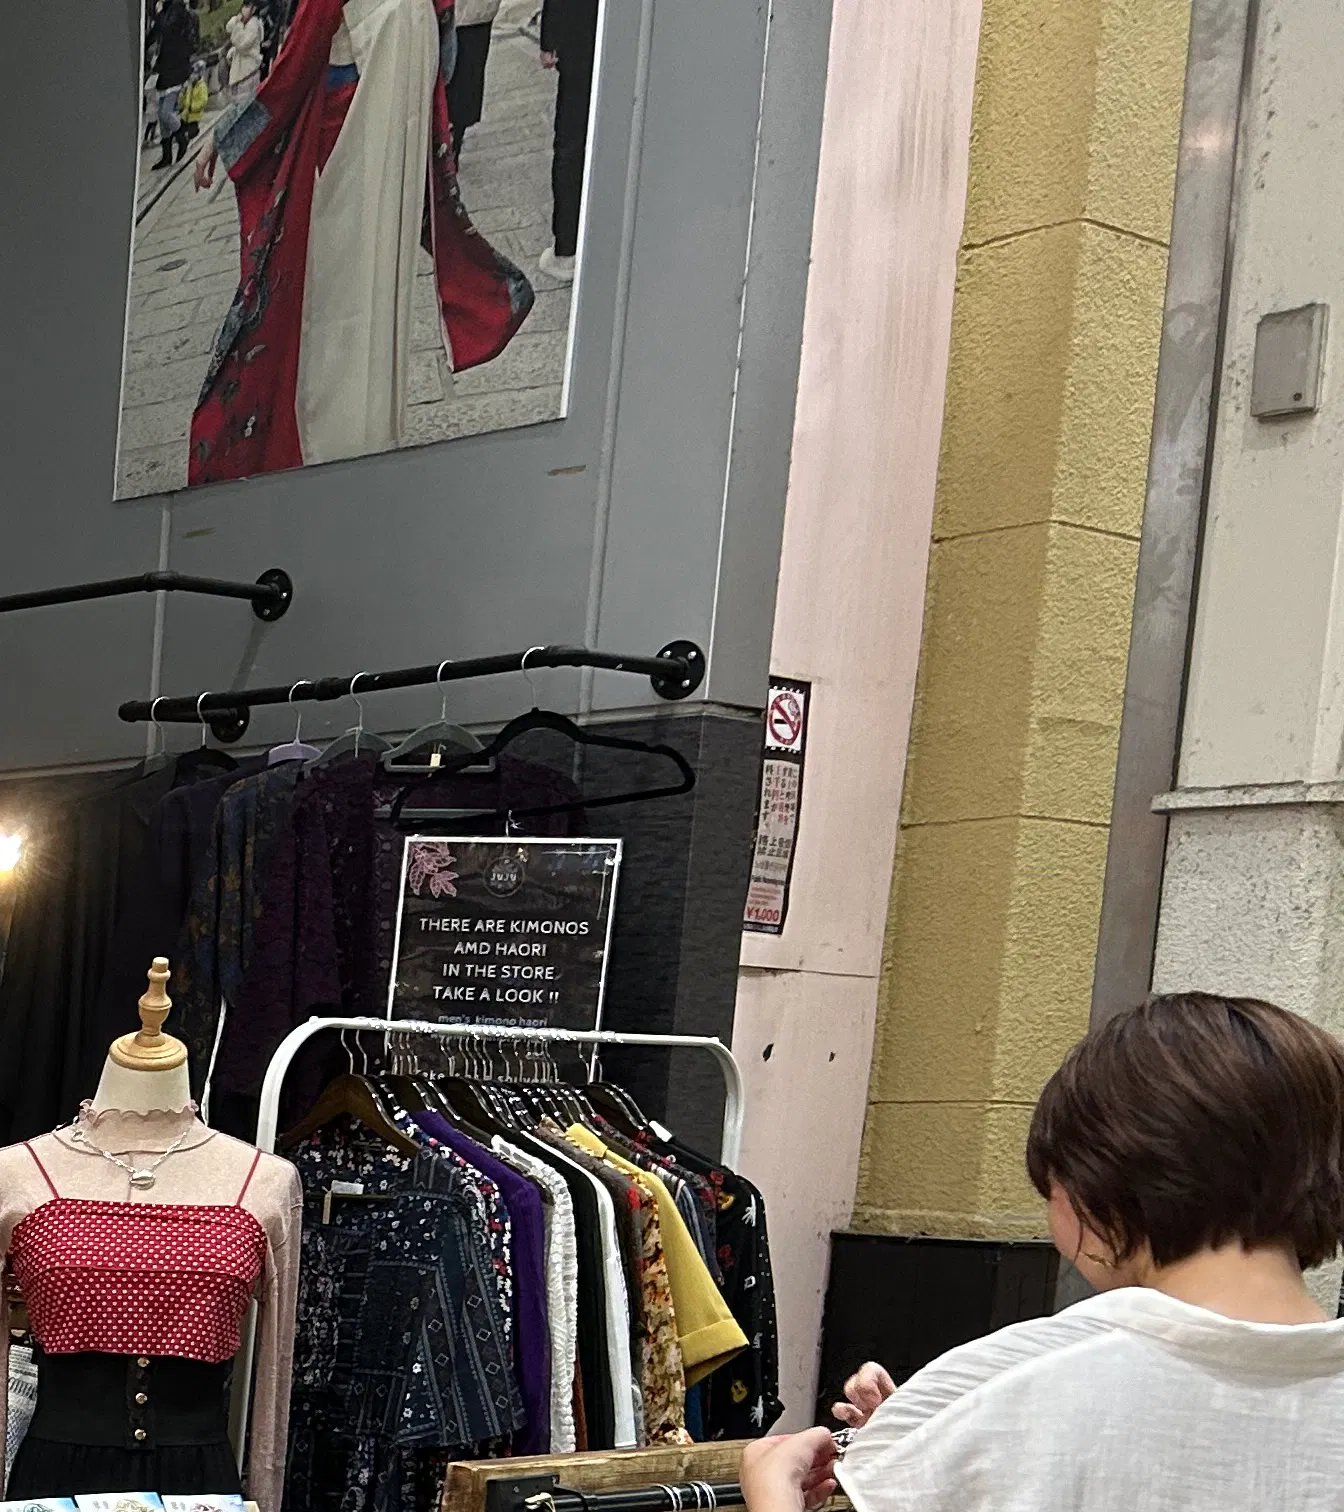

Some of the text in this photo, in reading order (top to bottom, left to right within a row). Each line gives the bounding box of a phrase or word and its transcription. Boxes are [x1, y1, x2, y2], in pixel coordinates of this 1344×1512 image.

[419, 918, 589, 935] THERE ARE KIMONOS
[453, 942, 547, 957] AMD HAORI
[442, 963, 555, 980] IN THE STORE
[432, 986, 476, 1001] TAKE
[480, 987, 491, 1001] A
[496, 988, 543, 1003] LOOK
